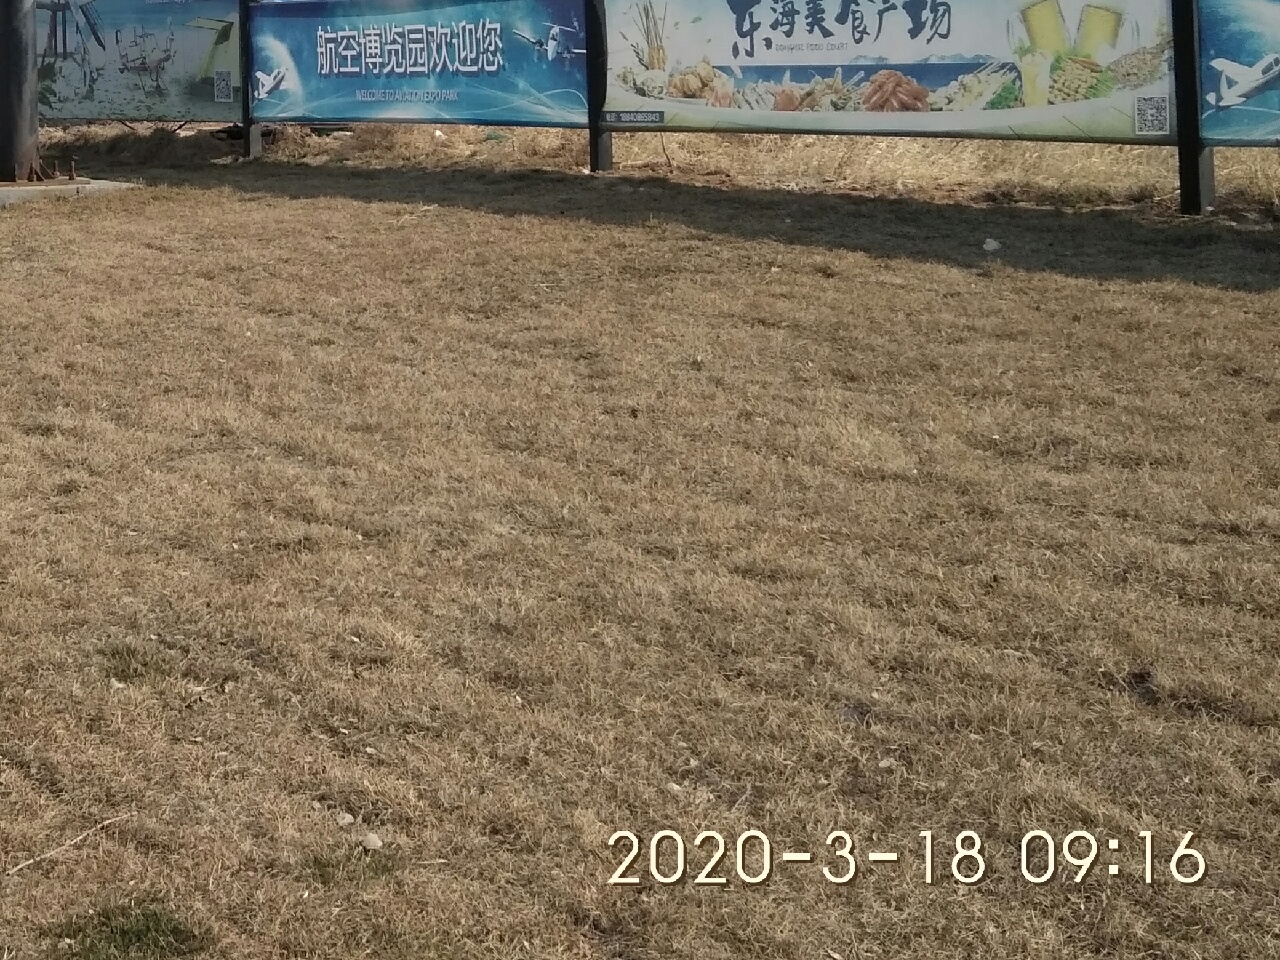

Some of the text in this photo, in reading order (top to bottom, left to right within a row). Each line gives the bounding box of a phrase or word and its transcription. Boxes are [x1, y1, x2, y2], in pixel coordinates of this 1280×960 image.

[316, 17, 504, 76] 航空博览园欢迎您
